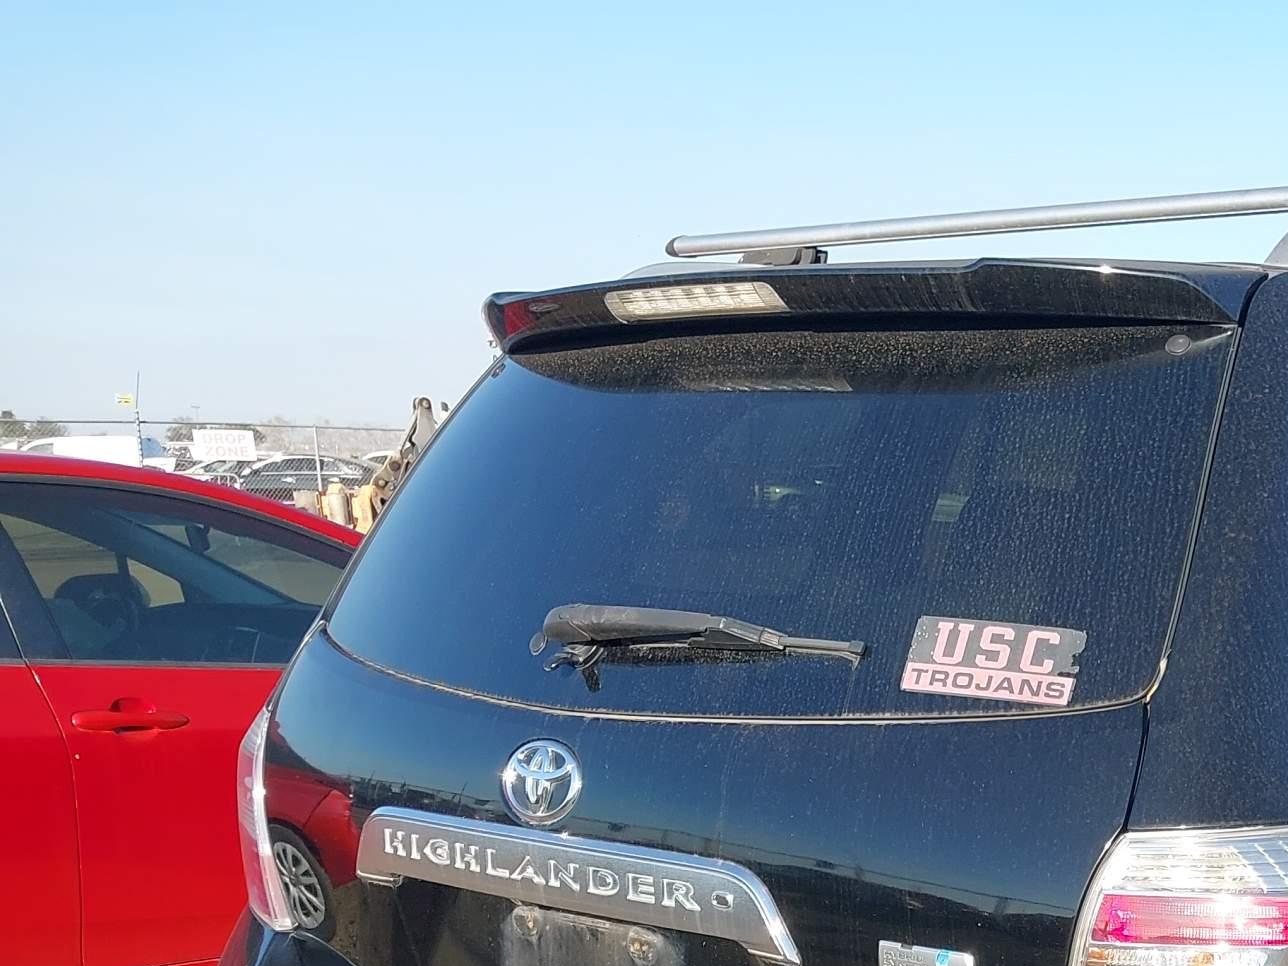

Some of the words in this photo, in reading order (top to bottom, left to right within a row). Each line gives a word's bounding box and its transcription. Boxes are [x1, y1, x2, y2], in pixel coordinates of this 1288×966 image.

[202, 433, 247, 444] DROP
[205, 446, 249, 457] ZONE
[932, 621, 1061, 674] USC
[910, 667, 1067, 700] TROJANS
[383, 828, 702, 912] HIGHLANDER
